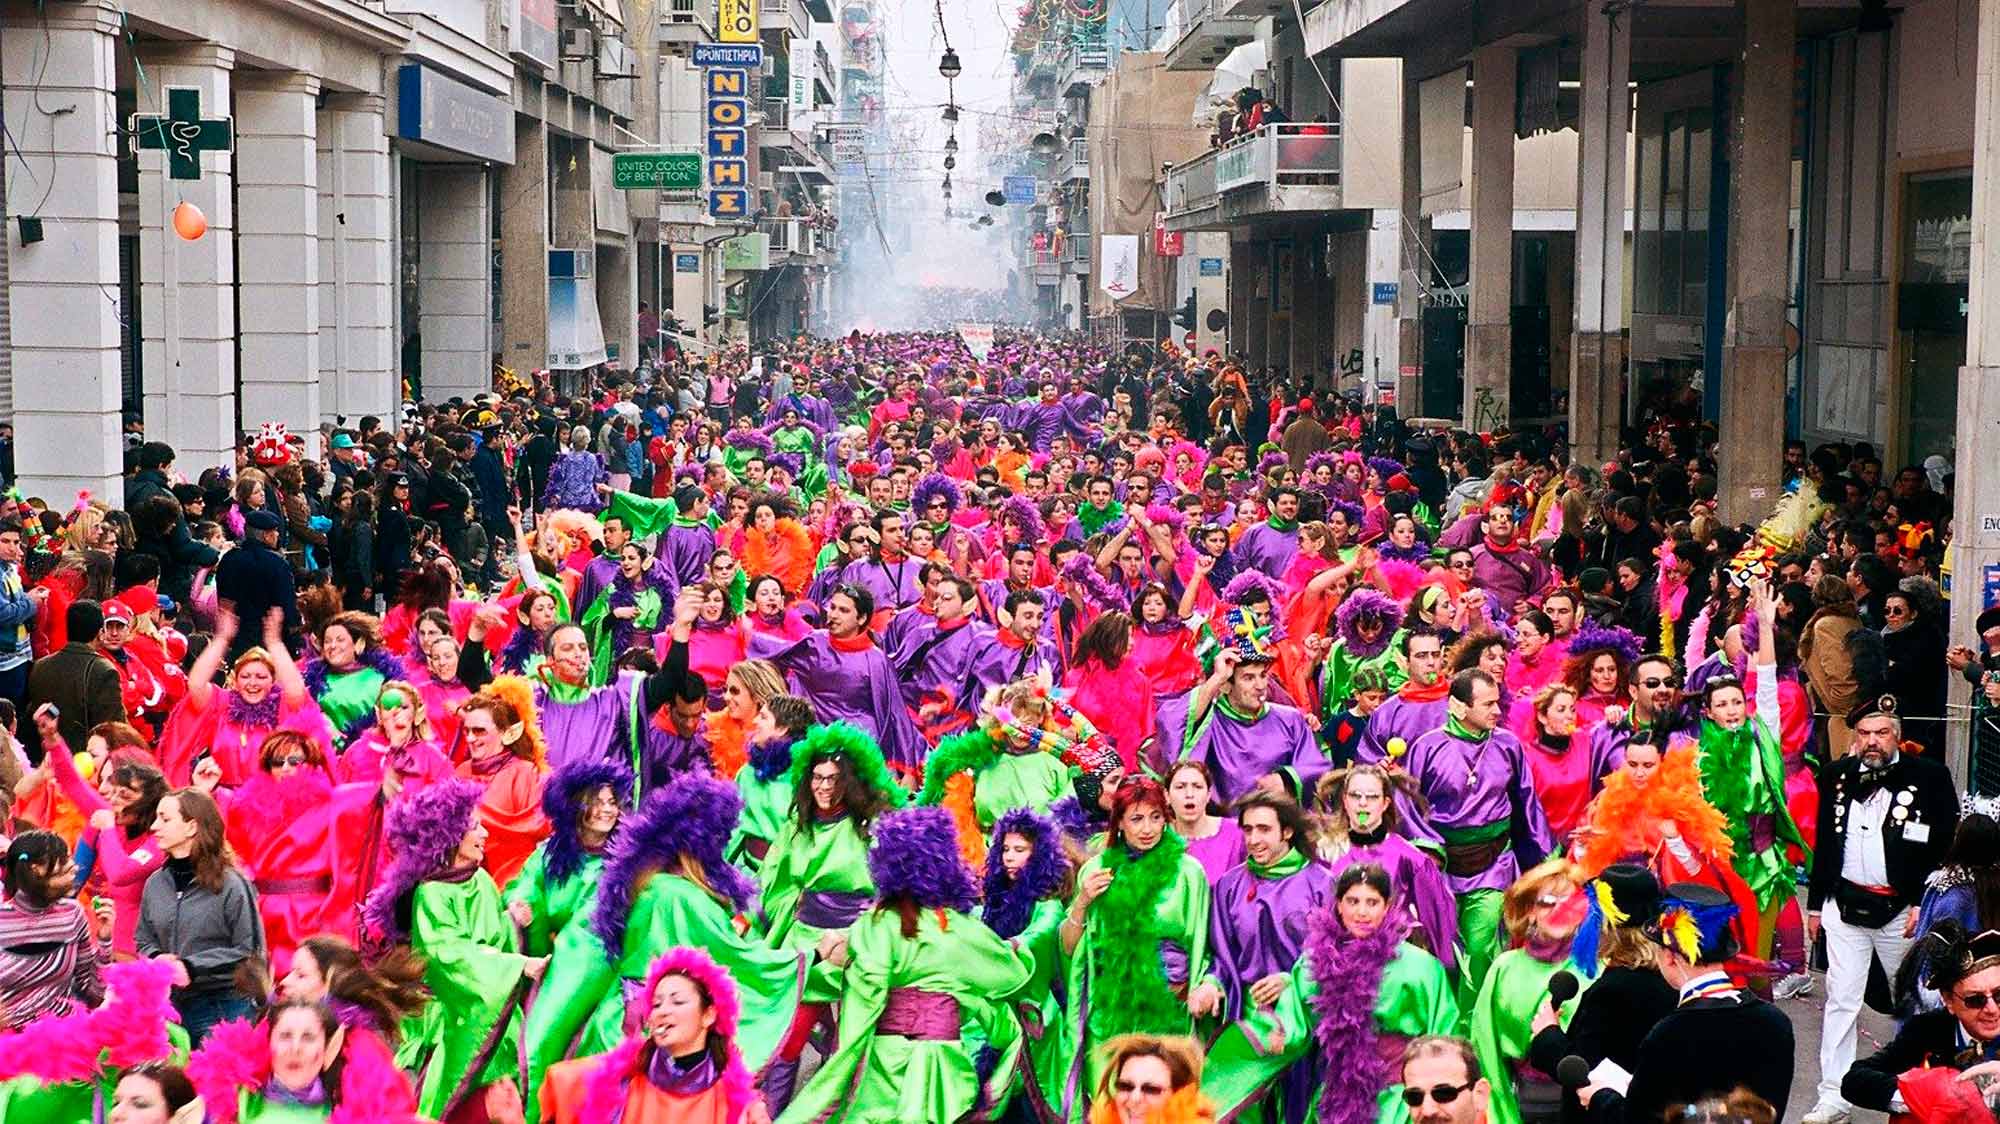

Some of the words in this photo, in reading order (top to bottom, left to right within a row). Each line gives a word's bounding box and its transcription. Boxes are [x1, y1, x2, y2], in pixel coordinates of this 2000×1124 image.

[696, 49, 758, 62] ΦΡΟΝΤΙΣΤΗΡΙΑ
[713, 74, 741, 212] ΝΟΤΗΣ
[617, 161, 653, 171] UNITED
[656, 161, 699, 171] COLORS
[617, 172, 632, 181] OF
